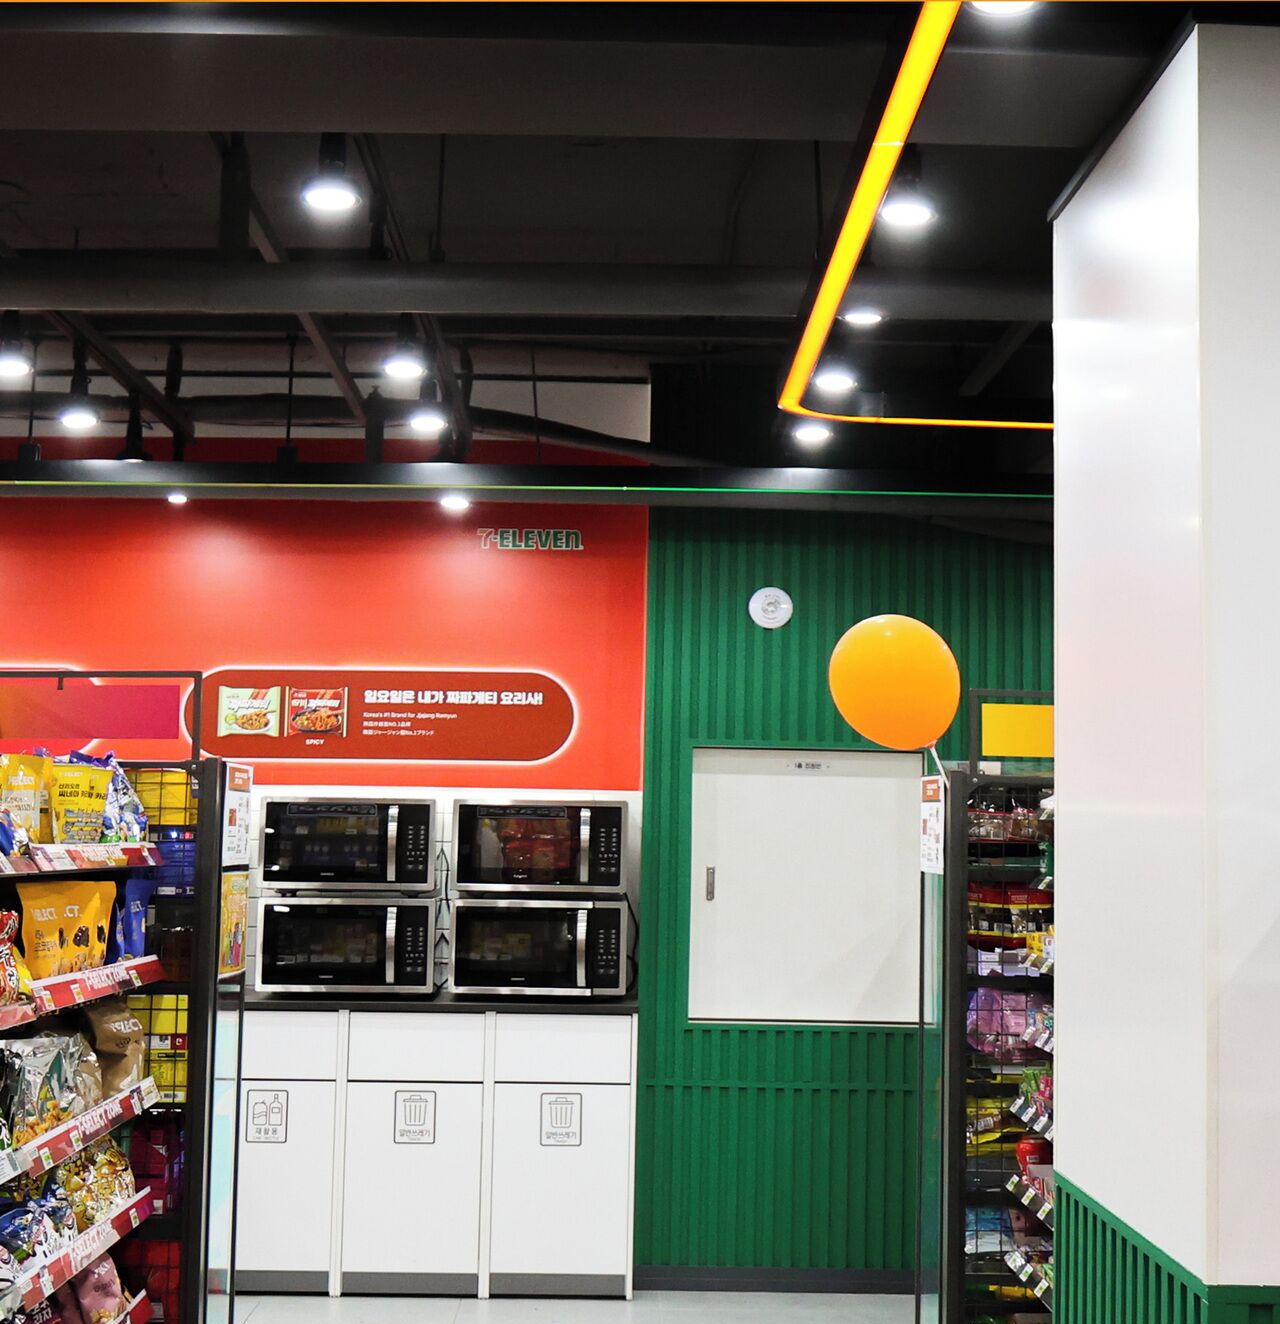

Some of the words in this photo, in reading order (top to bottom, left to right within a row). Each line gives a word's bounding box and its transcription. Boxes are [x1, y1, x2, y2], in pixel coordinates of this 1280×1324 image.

[364, 690, 415, 705] 일요일은
[417, 690, 444, 705] 내가
[446, 690, 497, 706] 짜파게티
[500, 691, 544, 706] 요리사!
